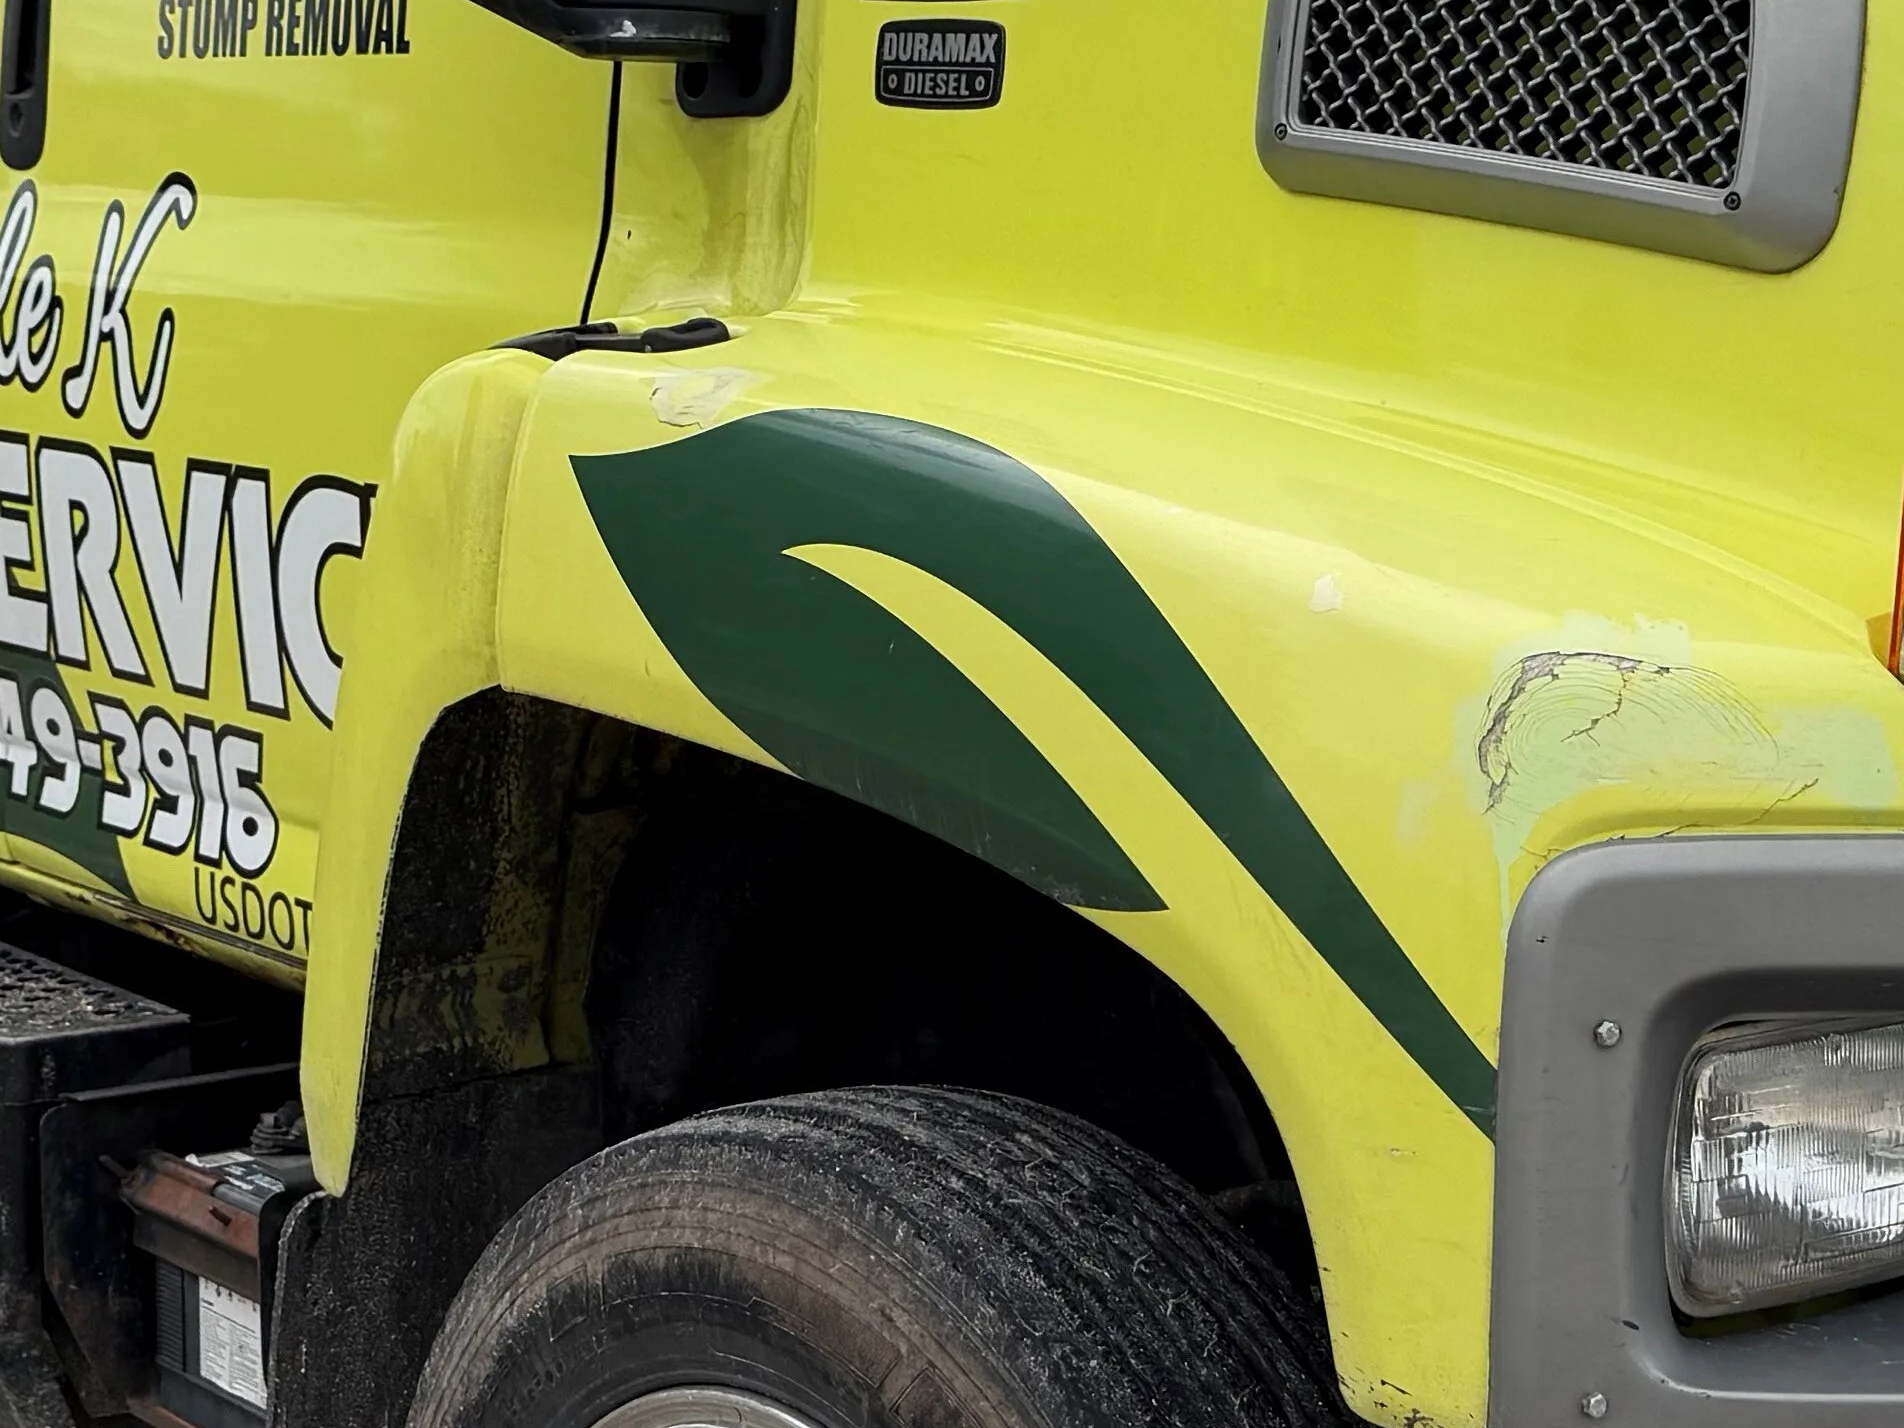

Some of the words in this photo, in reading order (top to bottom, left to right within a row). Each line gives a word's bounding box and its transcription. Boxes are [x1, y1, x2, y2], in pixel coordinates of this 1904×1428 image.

[883, 32, 998, 63] DURAMAX
[903, 72, 969, 96] DIESEL
[62, 171, 197, 439] K
[194, 866, 313, 956] USDOT
